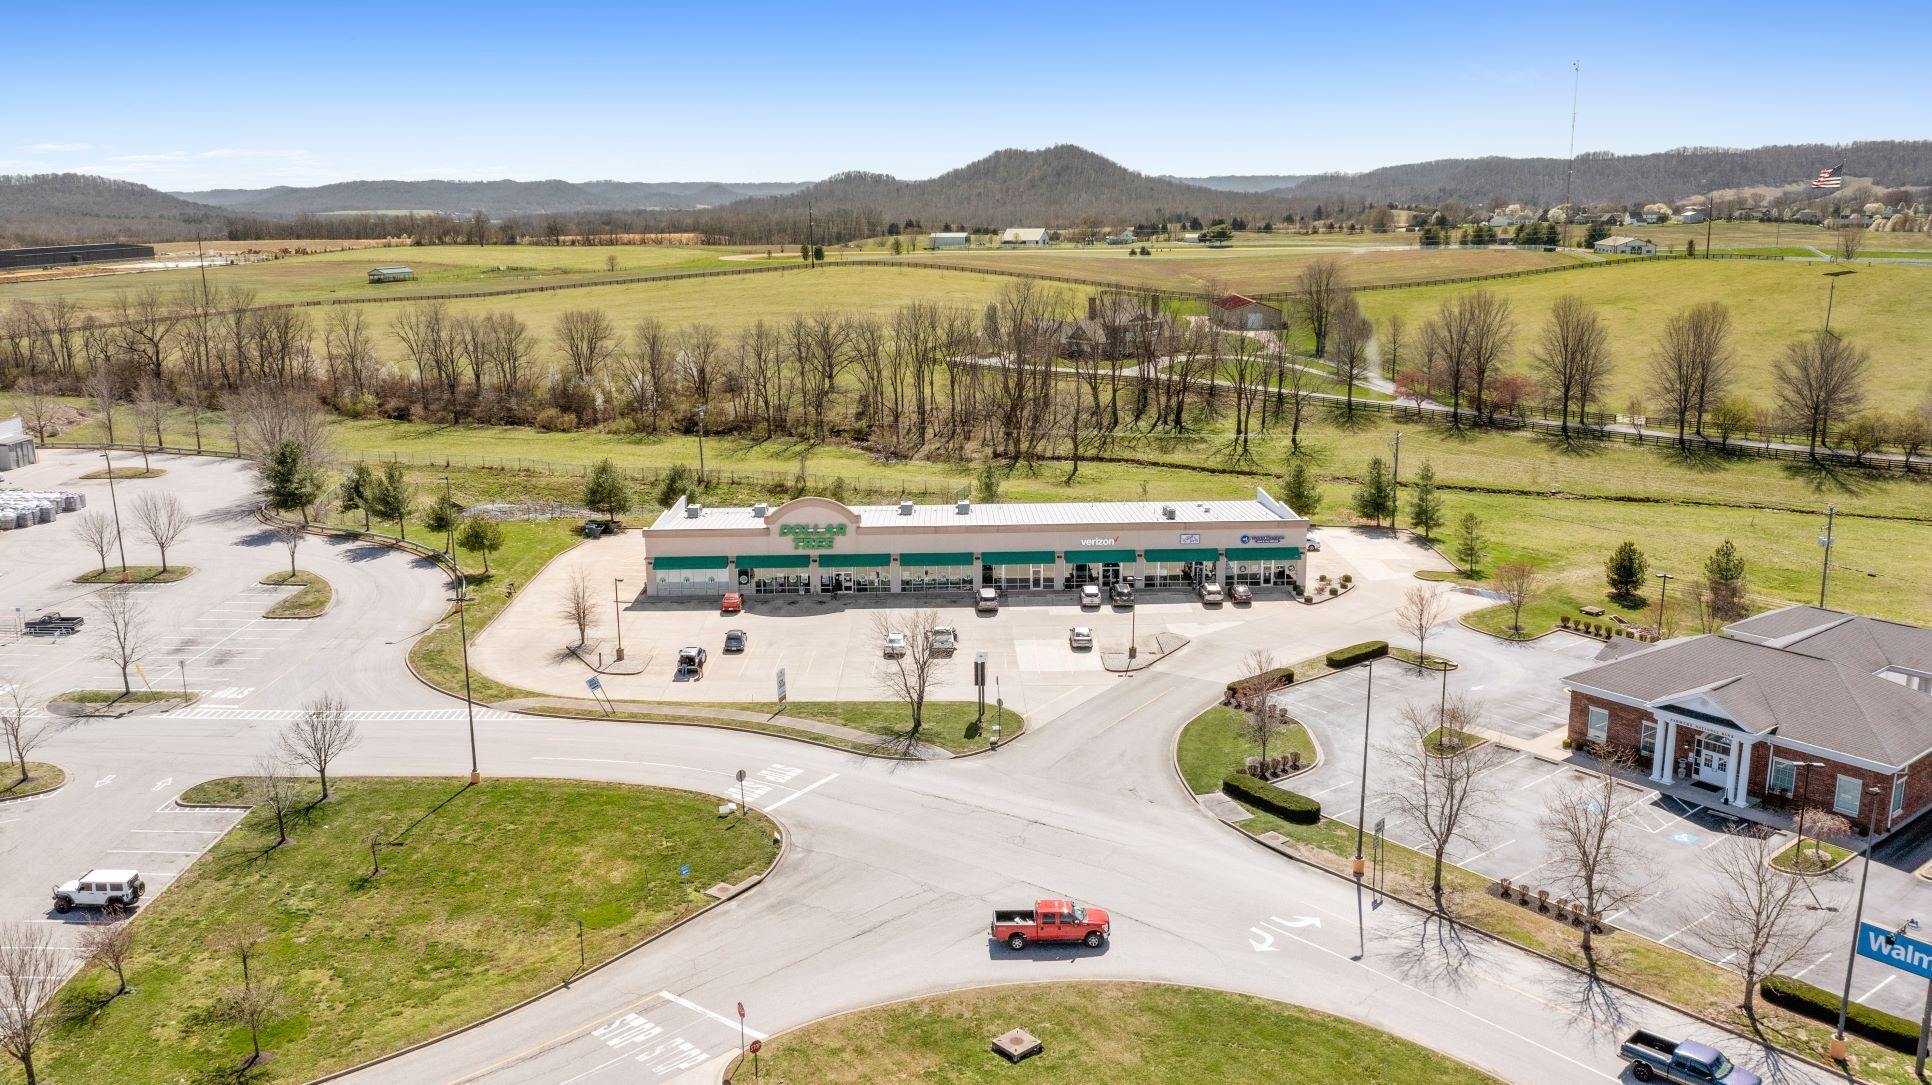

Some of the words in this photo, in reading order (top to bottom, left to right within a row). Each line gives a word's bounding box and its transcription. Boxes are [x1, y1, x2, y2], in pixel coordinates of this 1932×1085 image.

[779, 523, 847, 537] DOLLAR
[792, 537, 834, 550] TREE
[1081, 537, 1115, 546] verizon
[591, 1012, 664, 1049] STOP
[635, 1037, 711, 1076] STOP
